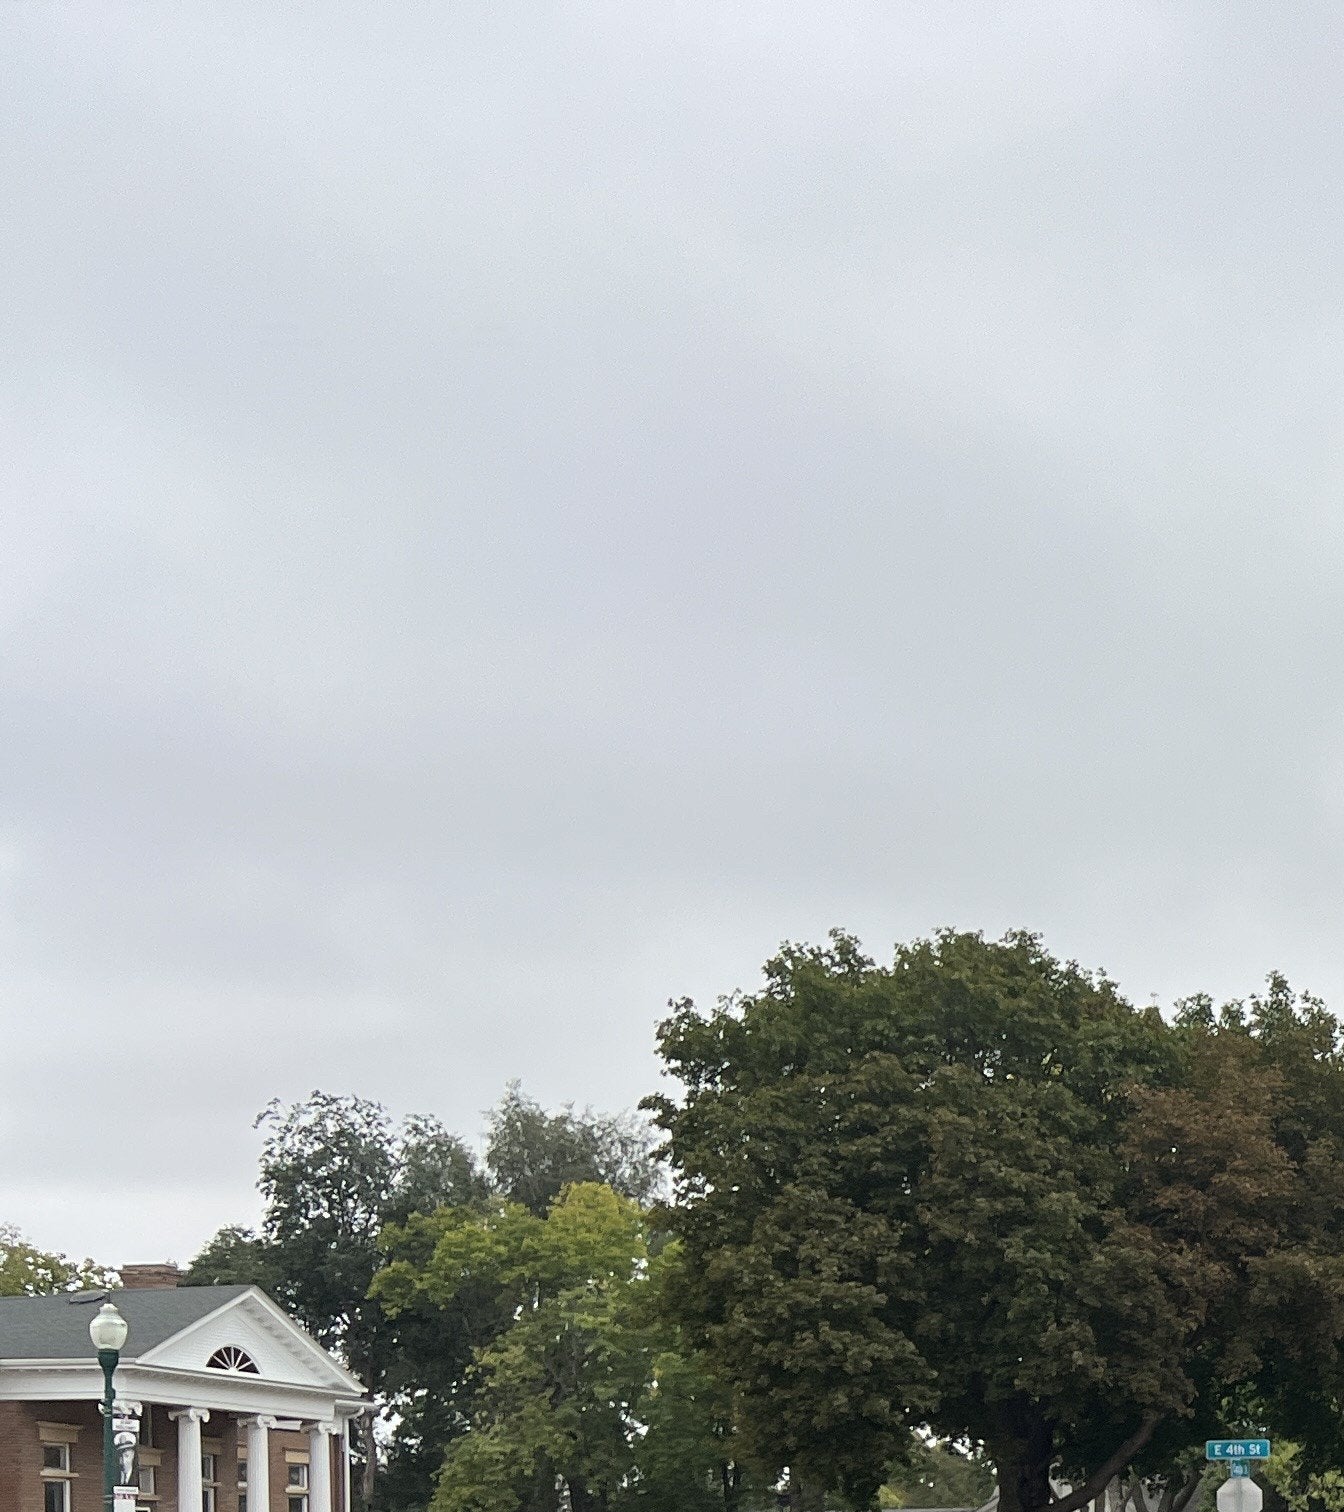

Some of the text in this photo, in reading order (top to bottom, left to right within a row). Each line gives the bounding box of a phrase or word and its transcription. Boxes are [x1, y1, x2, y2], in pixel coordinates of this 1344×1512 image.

[1214, 1443, 1261, 1456] E 4th St
